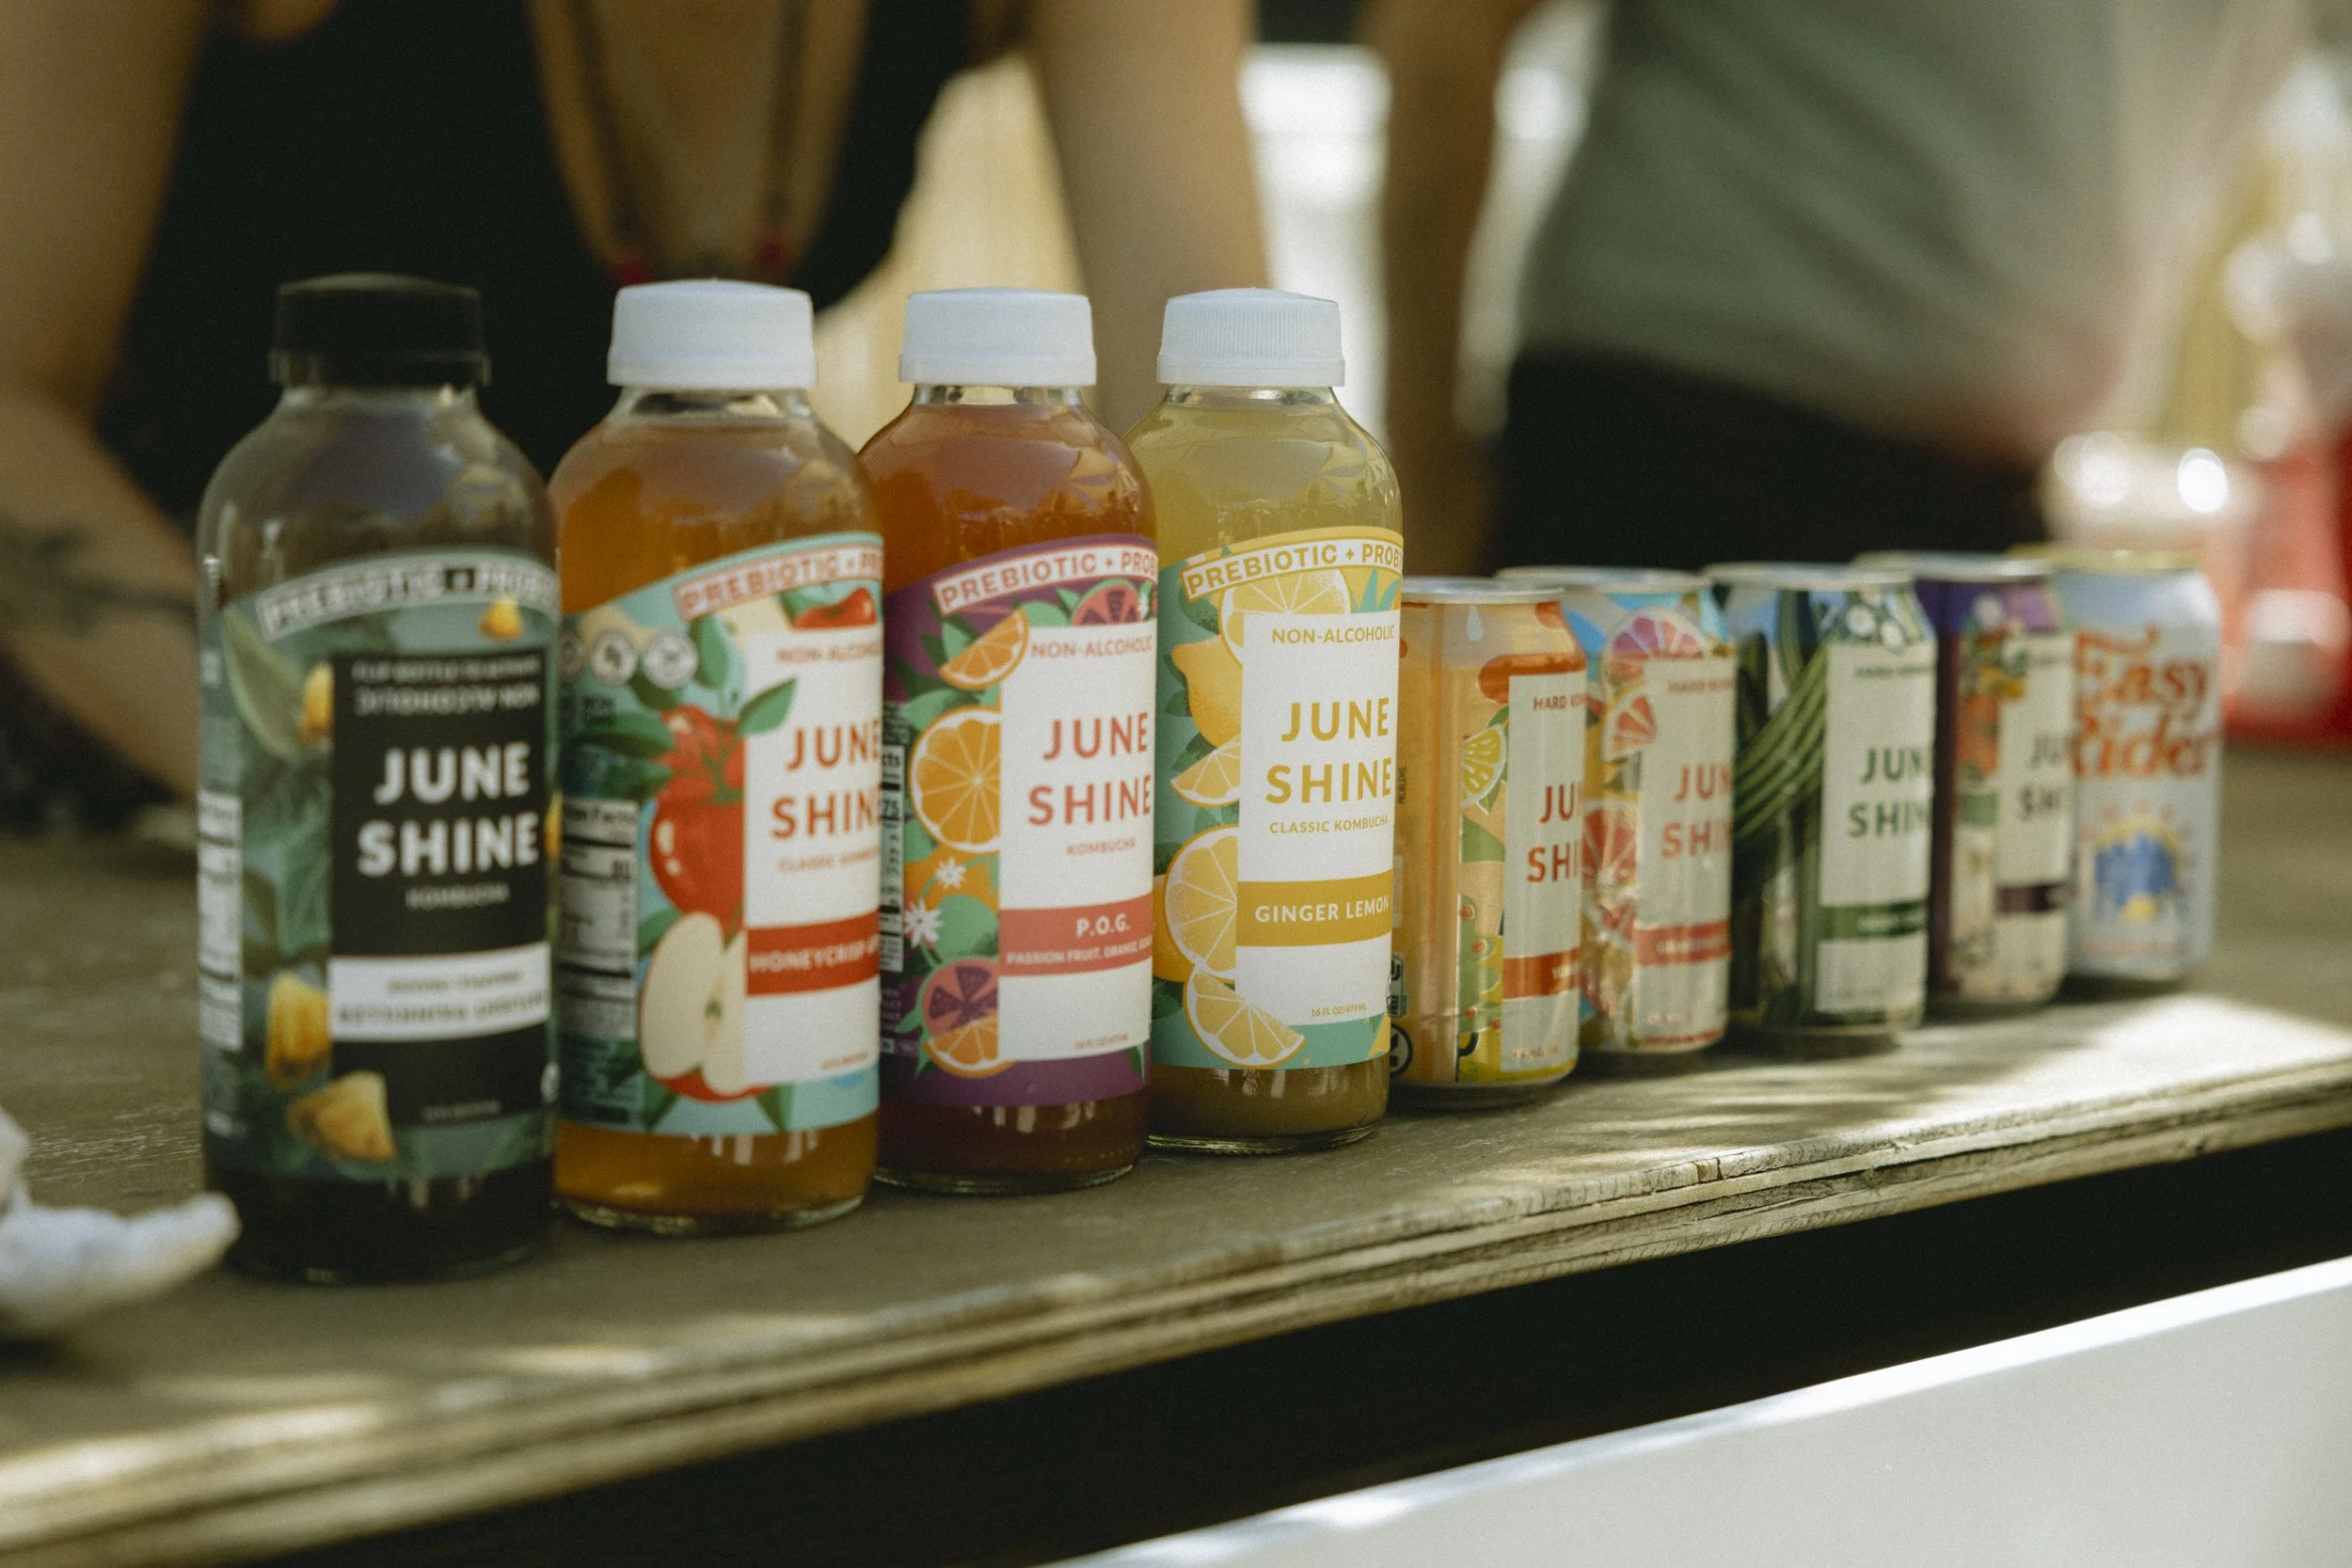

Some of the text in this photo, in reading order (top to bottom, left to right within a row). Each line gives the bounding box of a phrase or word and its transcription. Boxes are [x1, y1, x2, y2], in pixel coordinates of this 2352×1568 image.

[941, 553, 1097, 608] PREBIOTIC
[1187, 544, 1338, 594] PREBIOTIC
[1272, 625, 1394, 644] NON-ALCOHOLIC
[1281, 697, 1390, 742] JUNE
[1534, 696, 1567, 711] HARD
[1043, 712, 1149, 762] JUNE
[373, 741, 531, 805] JUNE
[1265, 757, 1392, 805] SHINE
[771, 786, 879, 839] SHIN
[1027, 775, 1152, 827] SHINE
[1270, 814, 1389, 834] CLASSIC KOMBUCHA
[357, 811, 540, 879] SHINE
[1075, 913, 1130, 938] P.O.G.
[1255, 895, 1390, 924] GINGER LEMON
[1006, 949, 1065, 964] PASSION
[1311, 1008, 1321, 1017] 16
